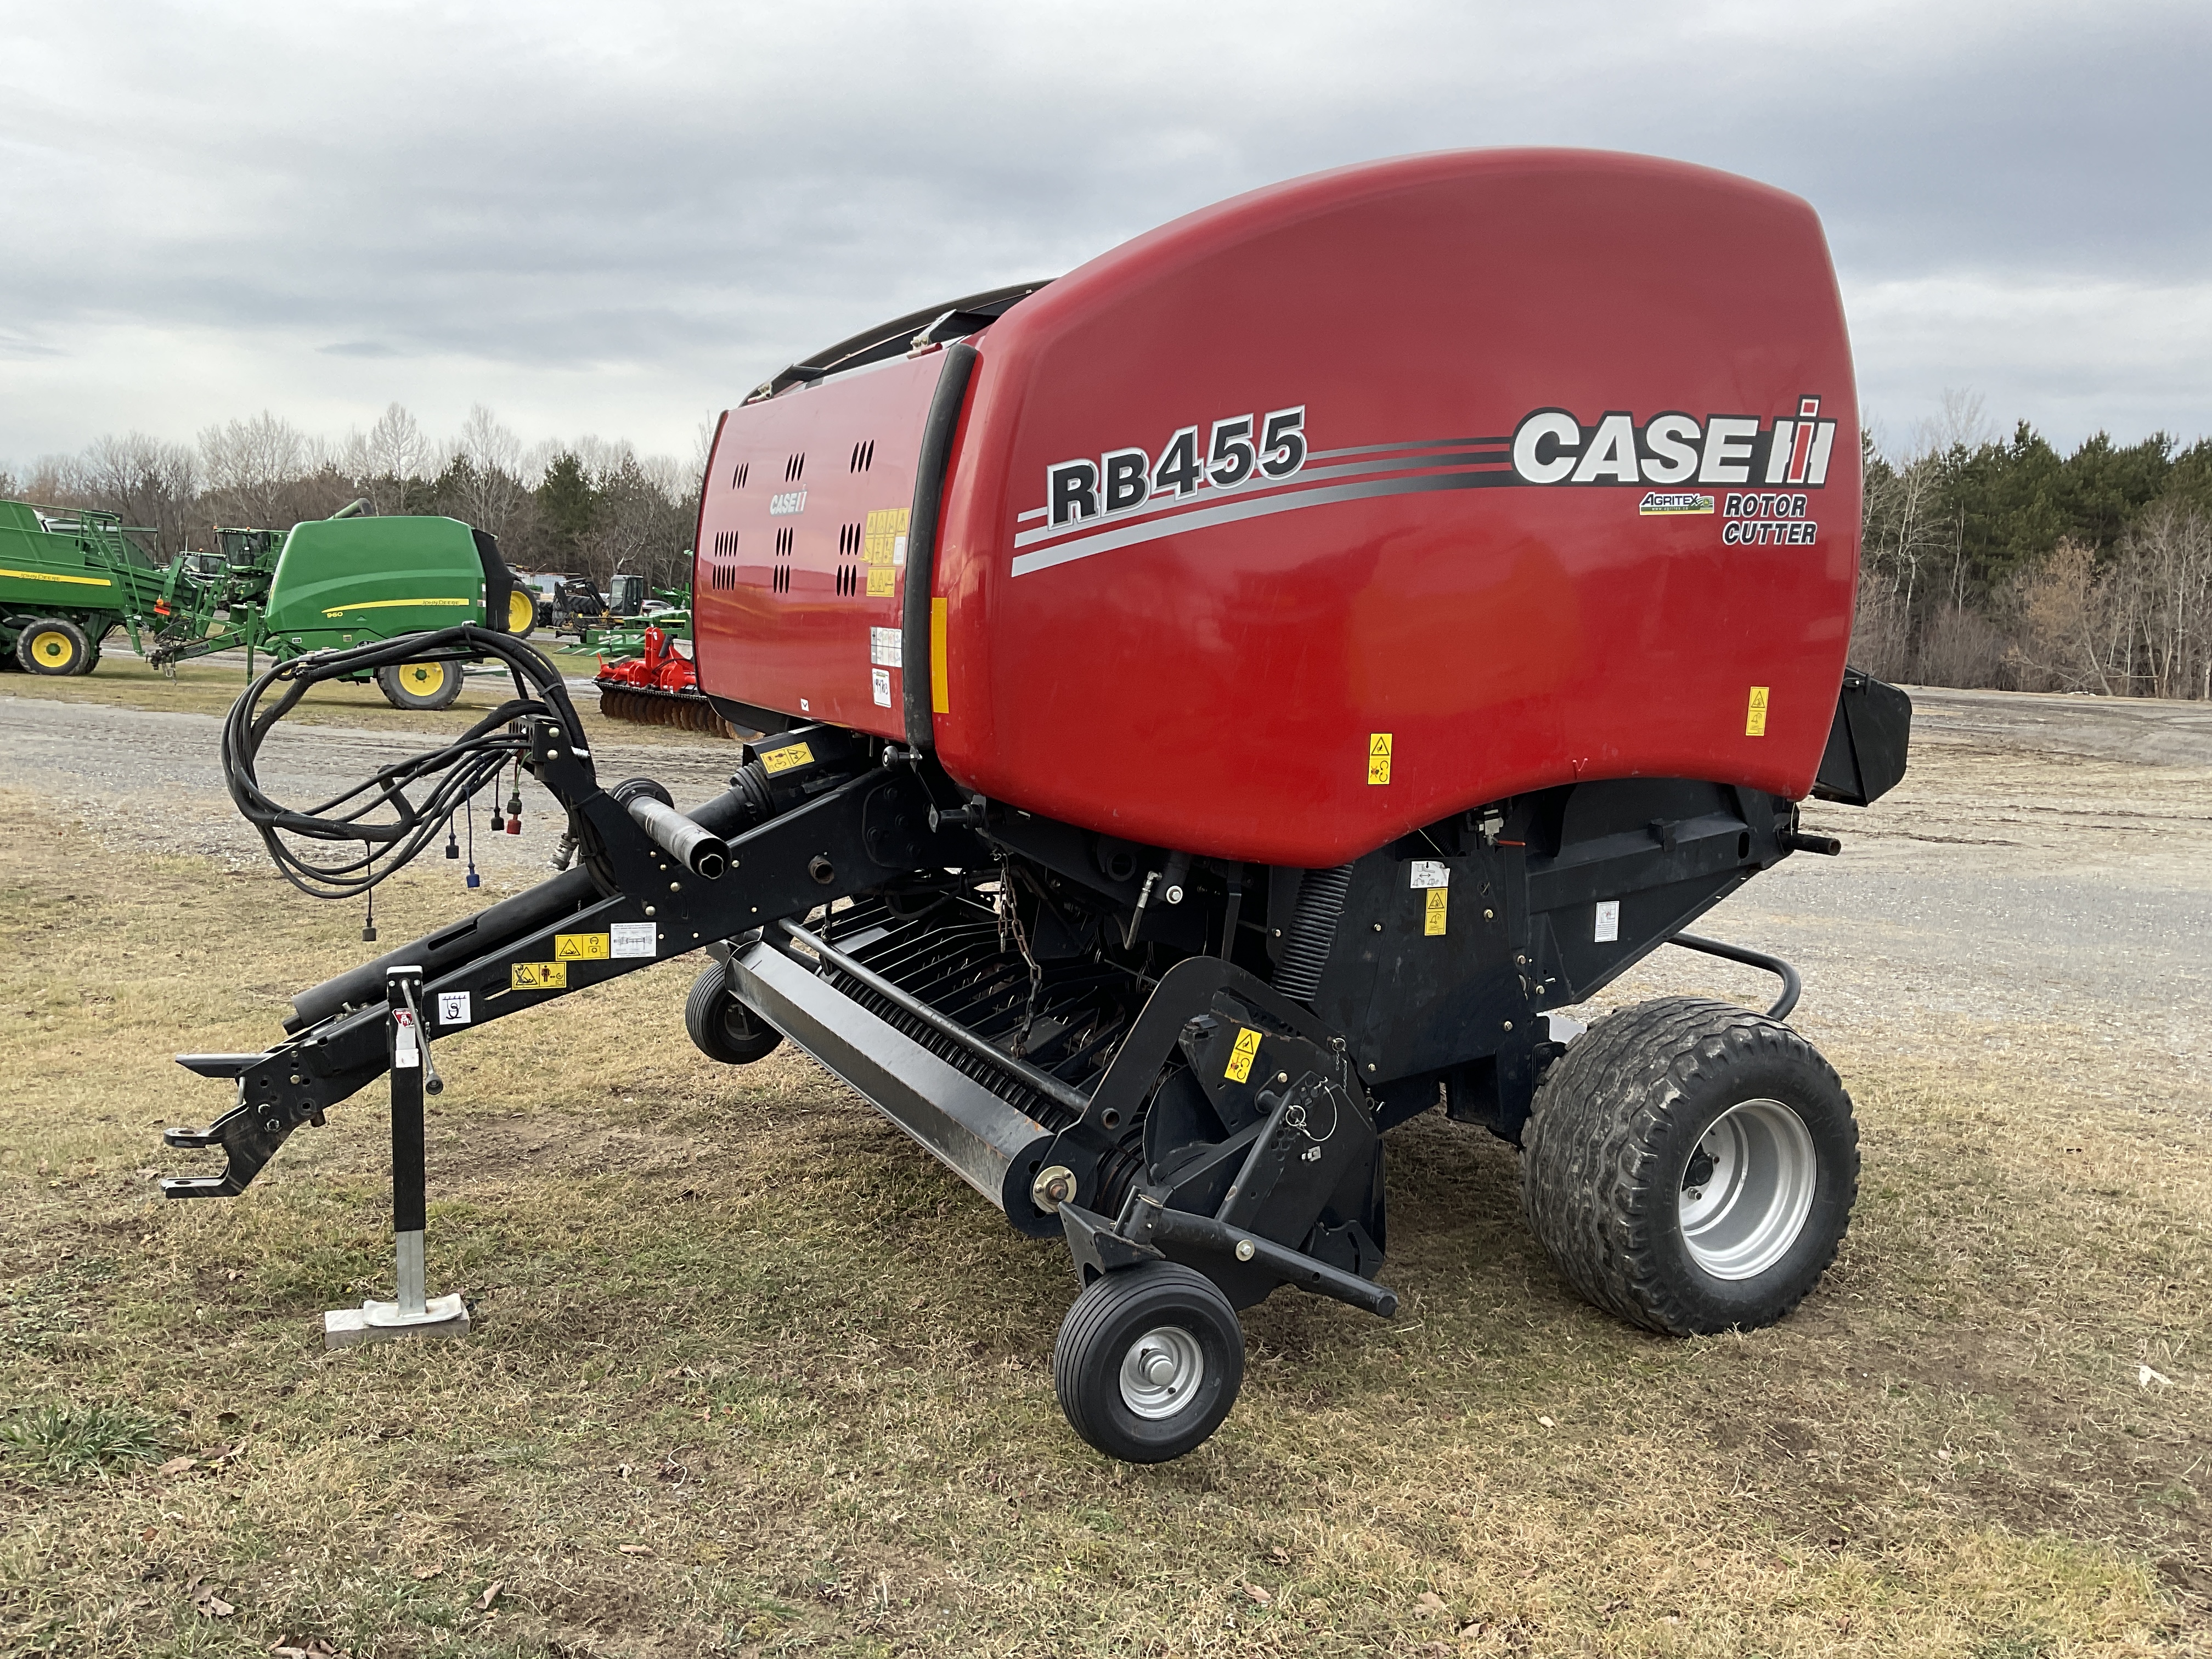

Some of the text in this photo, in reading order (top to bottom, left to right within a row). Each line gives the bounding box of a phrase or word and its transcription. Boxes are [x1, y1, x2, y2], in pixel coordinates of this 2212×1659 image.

[1512, 411, 1759, 484] CASE
[1046, 404, 1308, 531] RB455
[770, 493, 798, 515] CASE
[1641, 494, 1699, 506] AGRITEX
[1723, 493, 1807, 517] ROTOR
[1722, 521, 1818, 545] CUTTER
